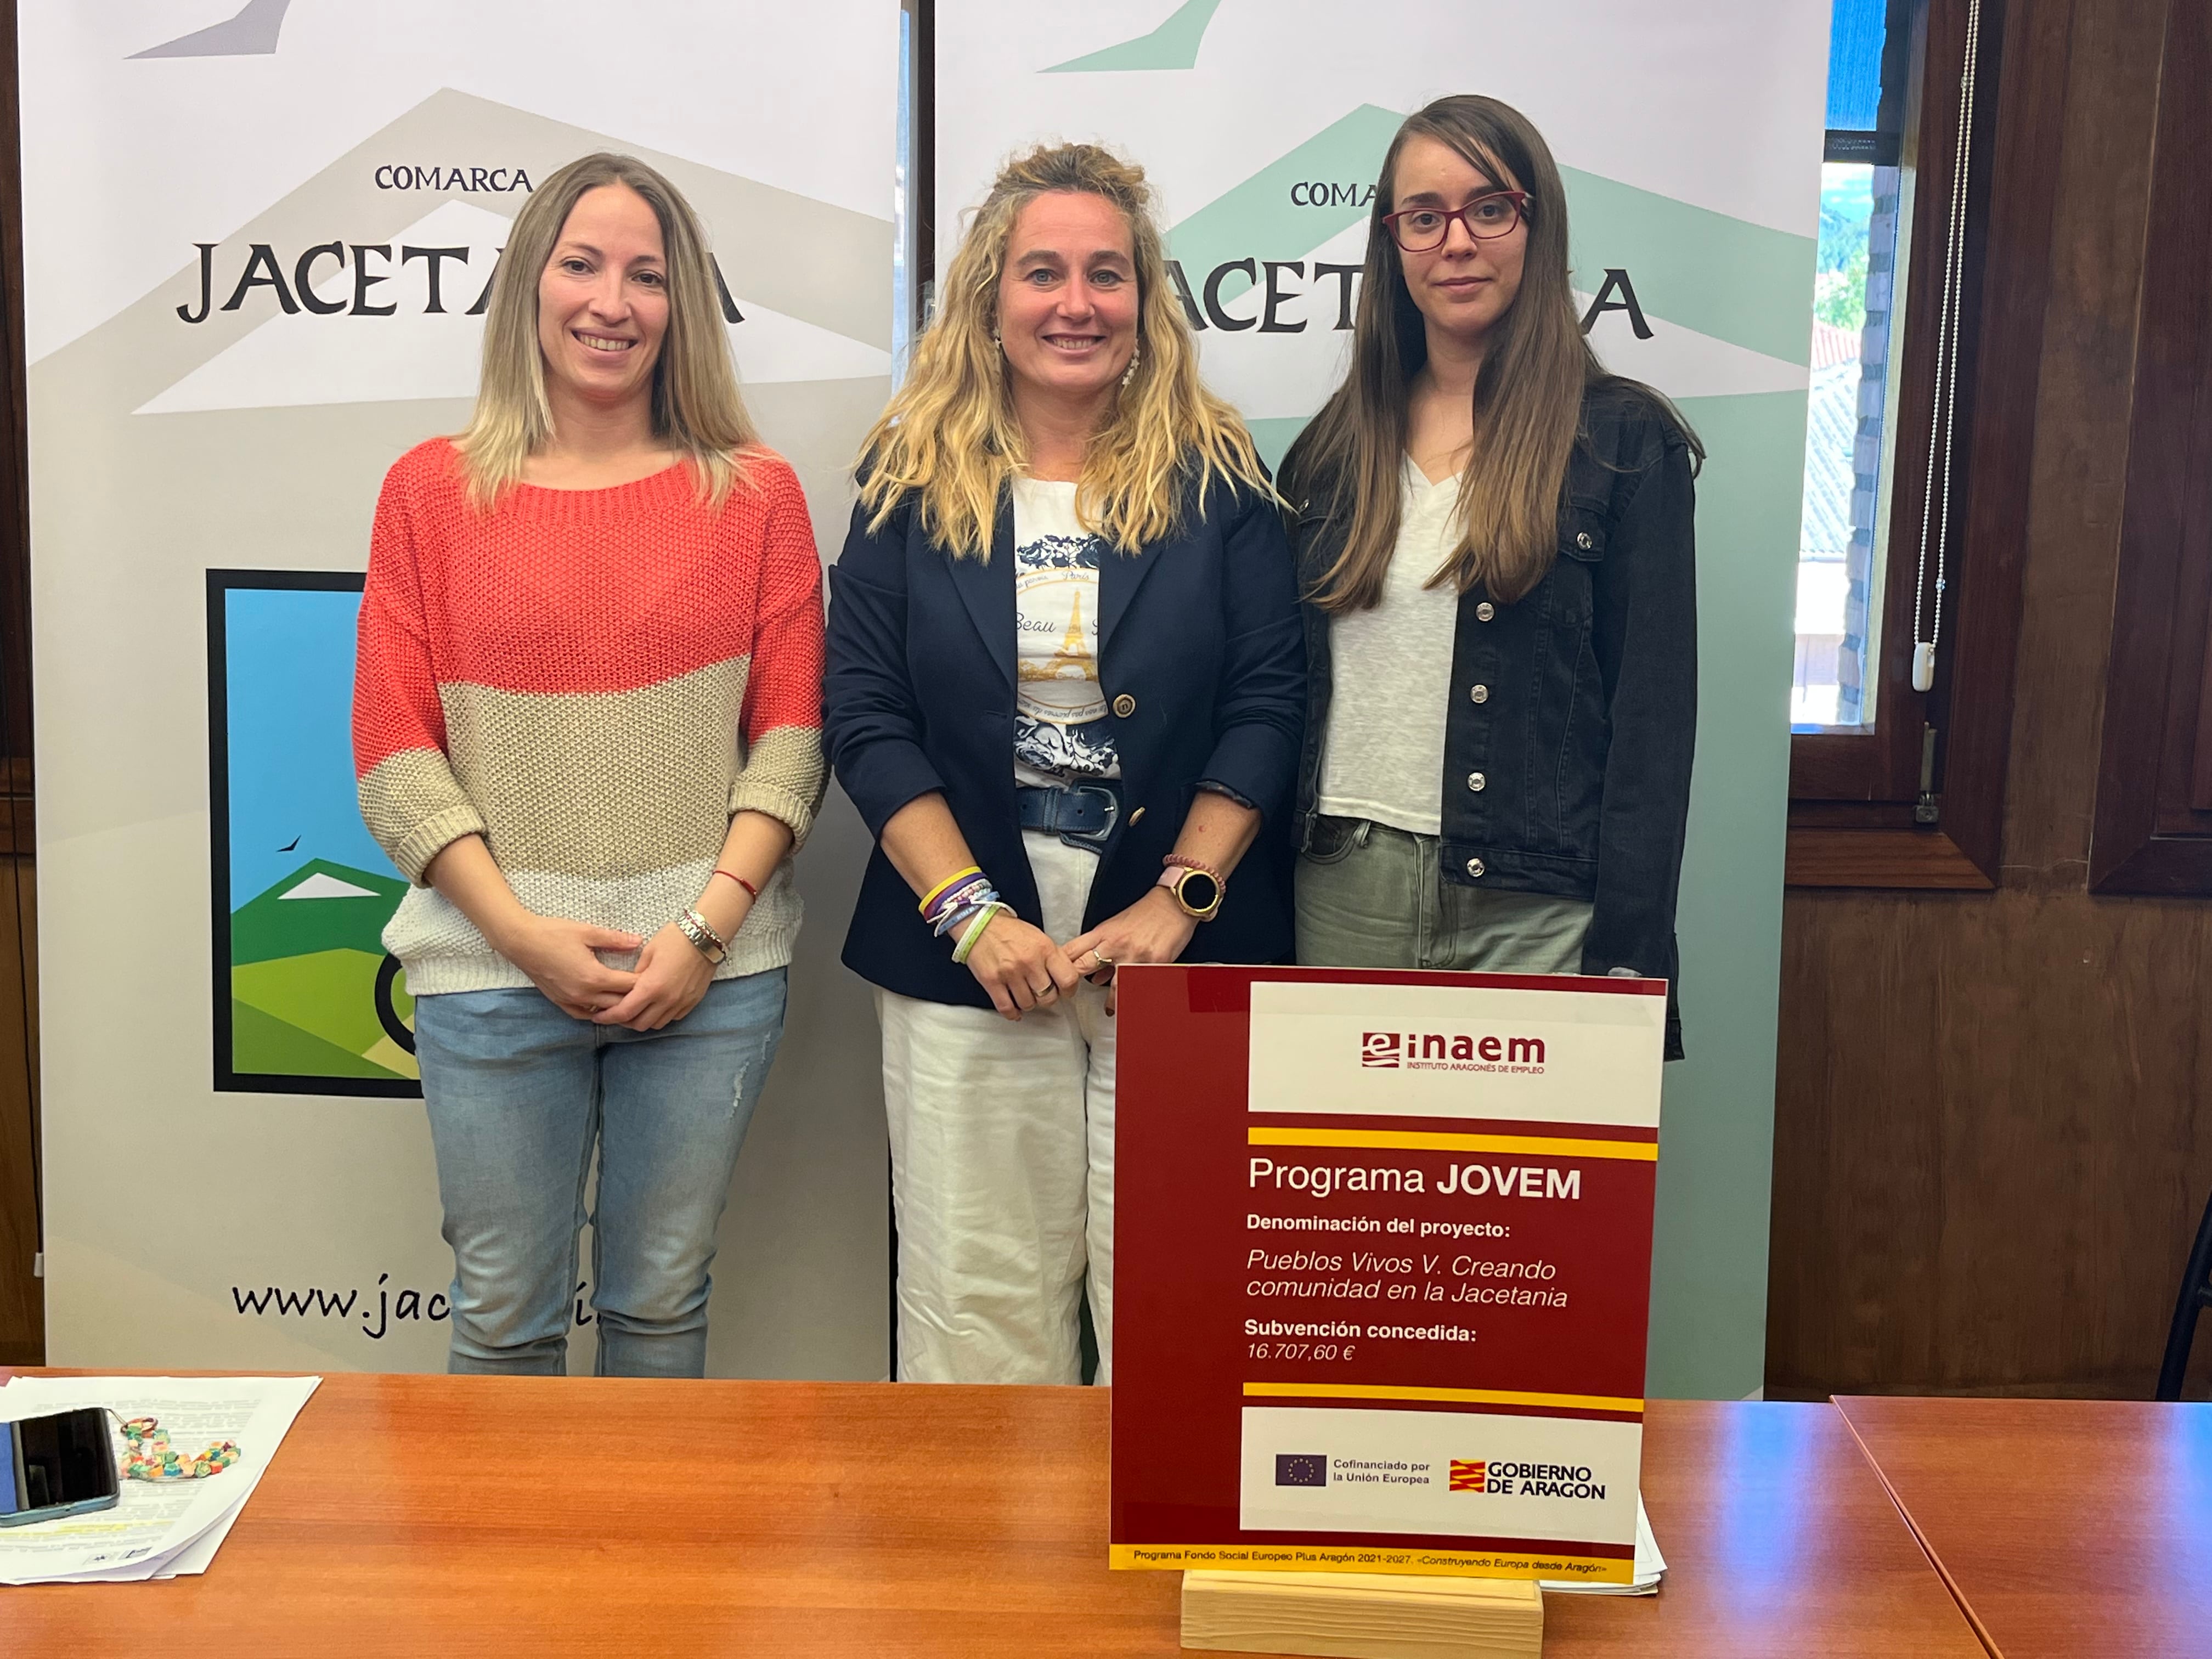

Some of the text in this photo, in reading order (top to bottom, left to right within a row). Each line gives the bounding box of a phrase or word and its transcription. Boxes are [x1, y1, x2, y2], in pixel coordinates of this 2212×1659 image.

[373, 163, 537, 194] COMARCA
[1291, 182, 1378, 206] COMA
[1407, 1034, 1545, 1063] inaem
[1407, 1062, 1449, 1070] INSTITUTO
[1511, 1066, 1545, 1074] EMPLEO
[1250, 1158, 1581, 1200] Programa JOVEM
[1247, 1214, 1510, 1239] Denominación del proyecto:
[1247, 1249, 1556, 1280] Pueblos Vivos V. Creando
[1246, 1278, 1567, 1307] comunidad en la Jacetania
[1245, 1319, 1476, 1342] Subvención concedida:
[1249, 1342, 1356, 1361] 16.707,60 €
[1333, 1459, 1430, 1475] Cofinanciado por
[1487, 1462, 1594, 1482] GOBIERNO
[1333, 1472, 1430, 1486] la Unión Europea
[1485, 1480, 1606, 1500] DE ARAGON
[1133, 1550, 1182, 1561] Programa
[1184, 1550, 1216, 1560] Fondo
[1218, 1550, 1249, 1560] Social
[1251, 1551, 1293, 1562] Europeo
[1295, 1551, 1317, 1561] Plus
[1319, 1552, 1355, 1564] Aragón
[1493, 1558, 1530, 1570] Europa
[1532, 1560, 1563, 1571] desde
